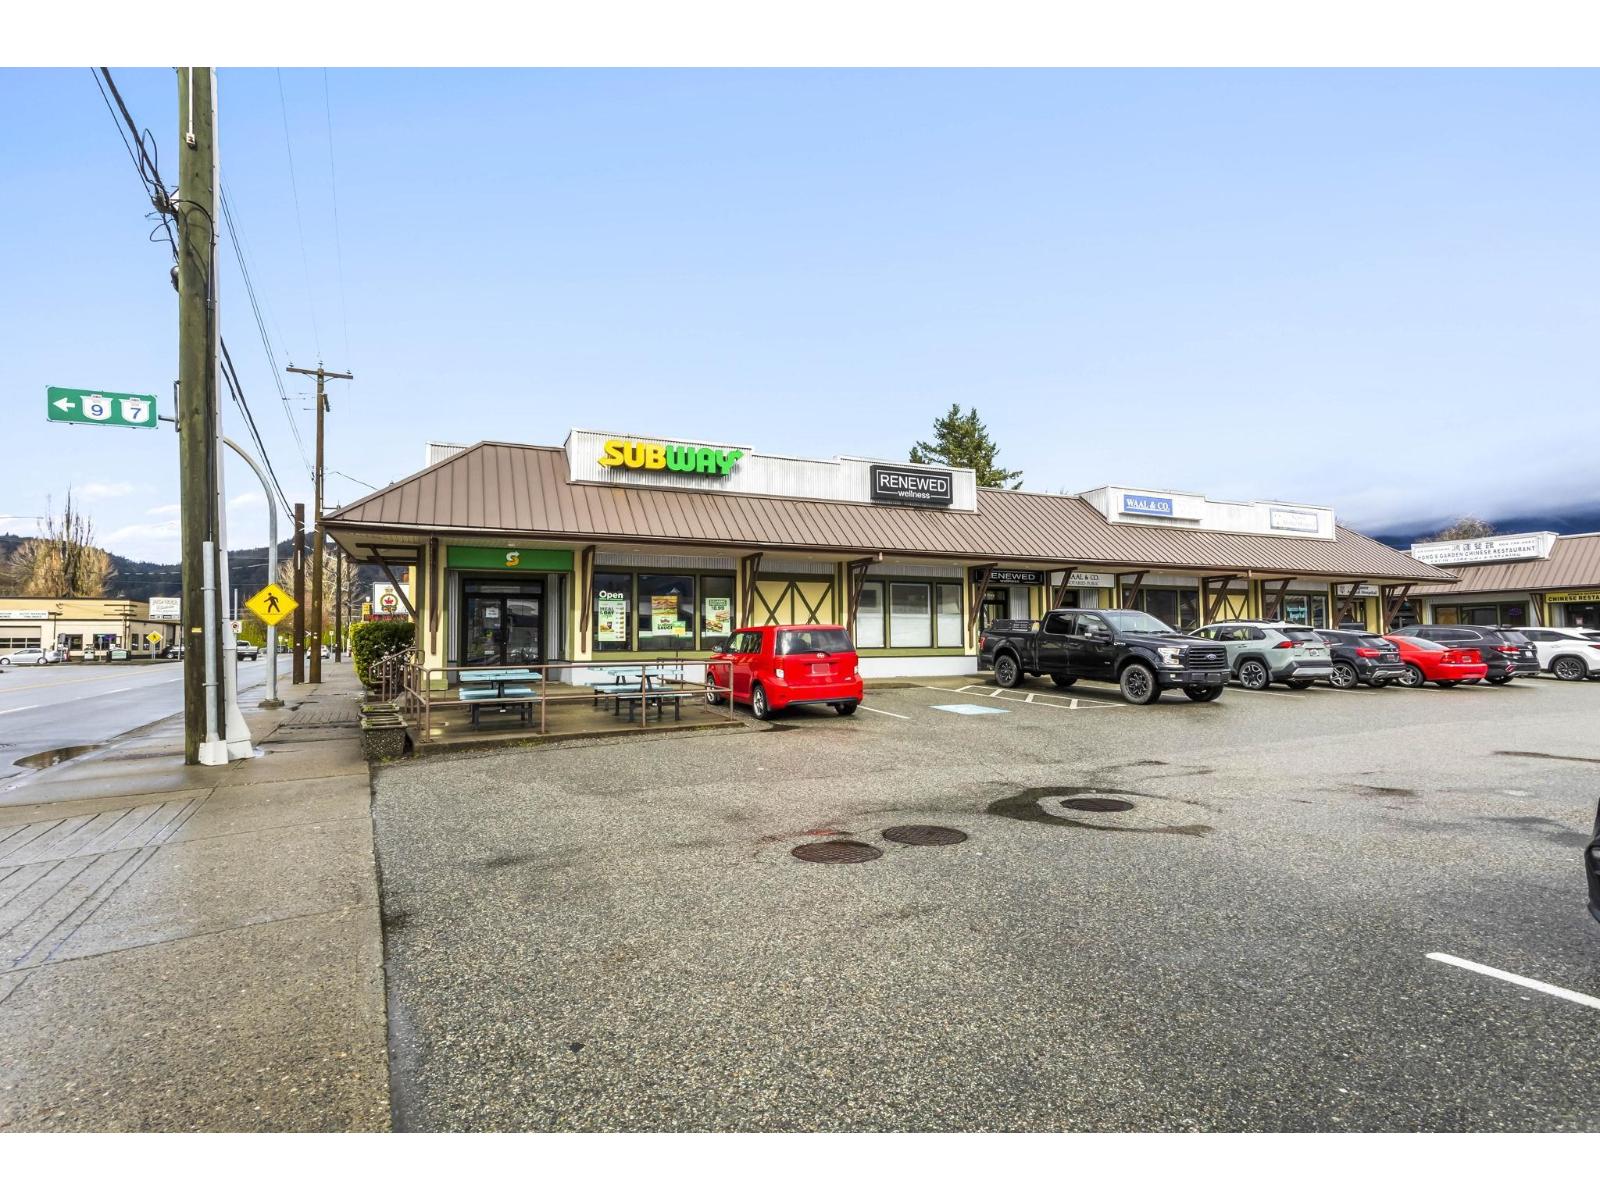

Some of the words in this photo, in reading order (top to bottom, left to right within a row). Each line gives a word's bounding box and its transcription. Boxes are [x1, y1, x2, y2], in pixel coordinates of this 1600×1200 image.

[91, 404, 103, 416] 9
[130, 407, 141, 419] 7
[598, 440, 744, 475] SUBWAY
[880, 474, 947, 492] RENEWED
[897, 490, 931, 499] wellness
[1126, 499, 1149, 509] WAAL
[1150, 501, 1156, 509] &
[1493, 546, 1535, 554] RESTAURANT
[991, 572, 1036, 580] ENEWED
[1070, 573, 1083, 581] AAL
[599, 590, 624, 600] Open
